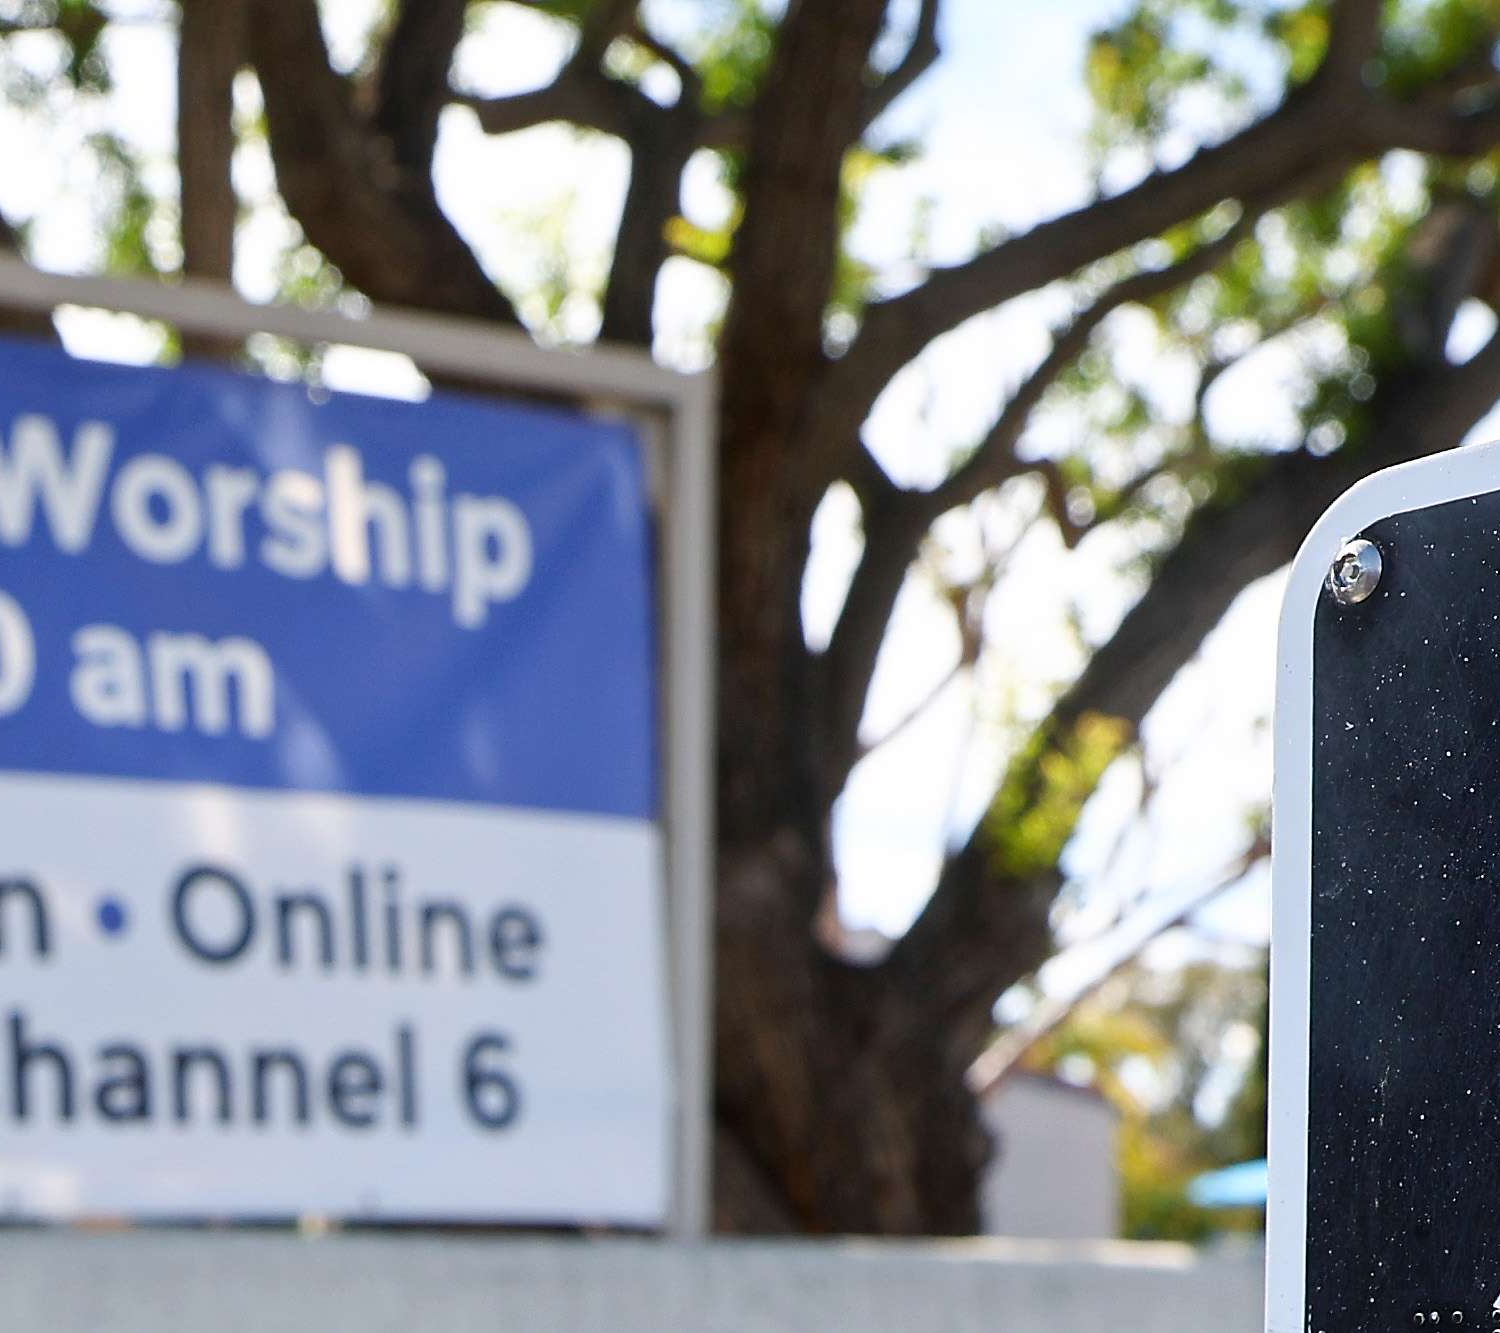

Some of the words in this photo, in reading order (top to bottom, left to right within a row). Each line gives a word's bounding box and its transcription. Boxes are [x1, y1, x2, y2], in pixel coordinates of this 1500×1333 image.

[69, 622, 276, 738] am
[171, 859, 542, 981] Online
[462, 1030, 521, 1131] 6
